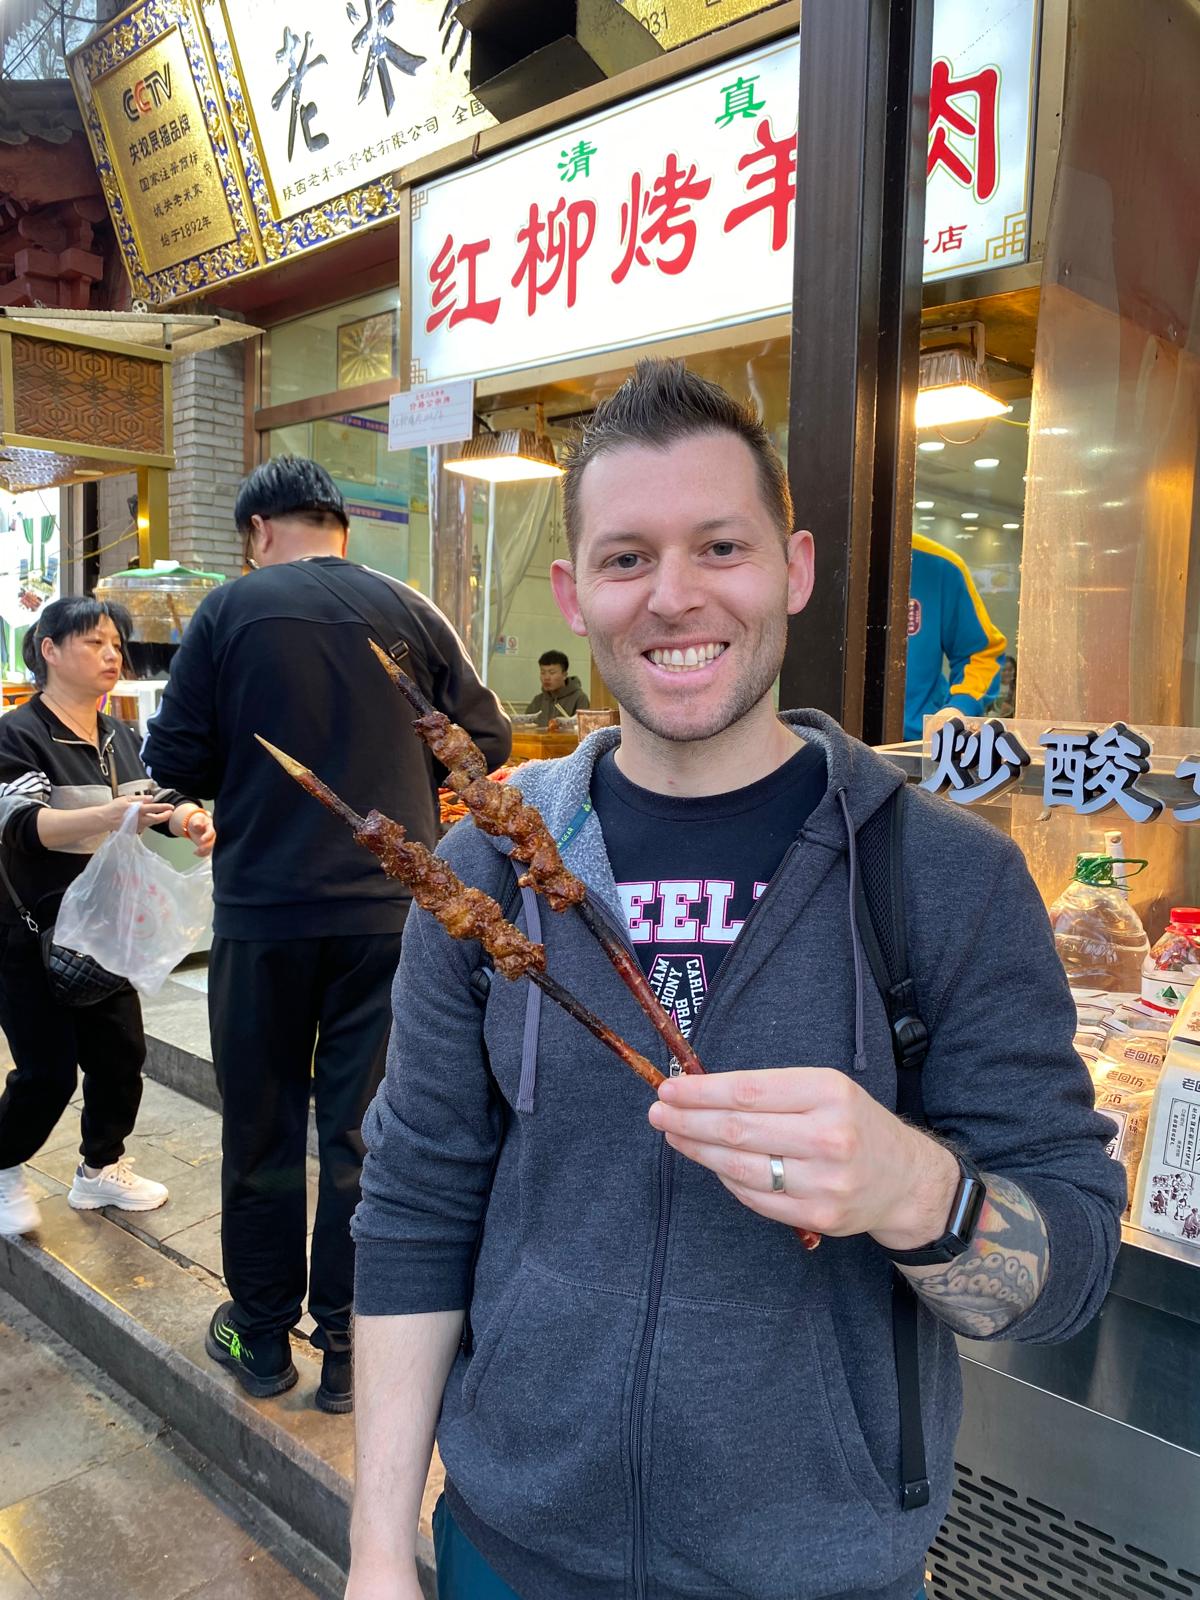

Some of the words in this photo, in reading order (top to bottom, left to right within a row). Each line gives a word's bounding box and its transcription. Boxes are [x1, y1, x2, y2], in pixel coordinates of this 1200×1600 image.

[122, 62, 172, 122] CCTV
[128, 113, 191, 166] 央视展播品牌
[616, 879, 769, 945] EEL
[1123, 1047, 1161, 1066] 老回坊
